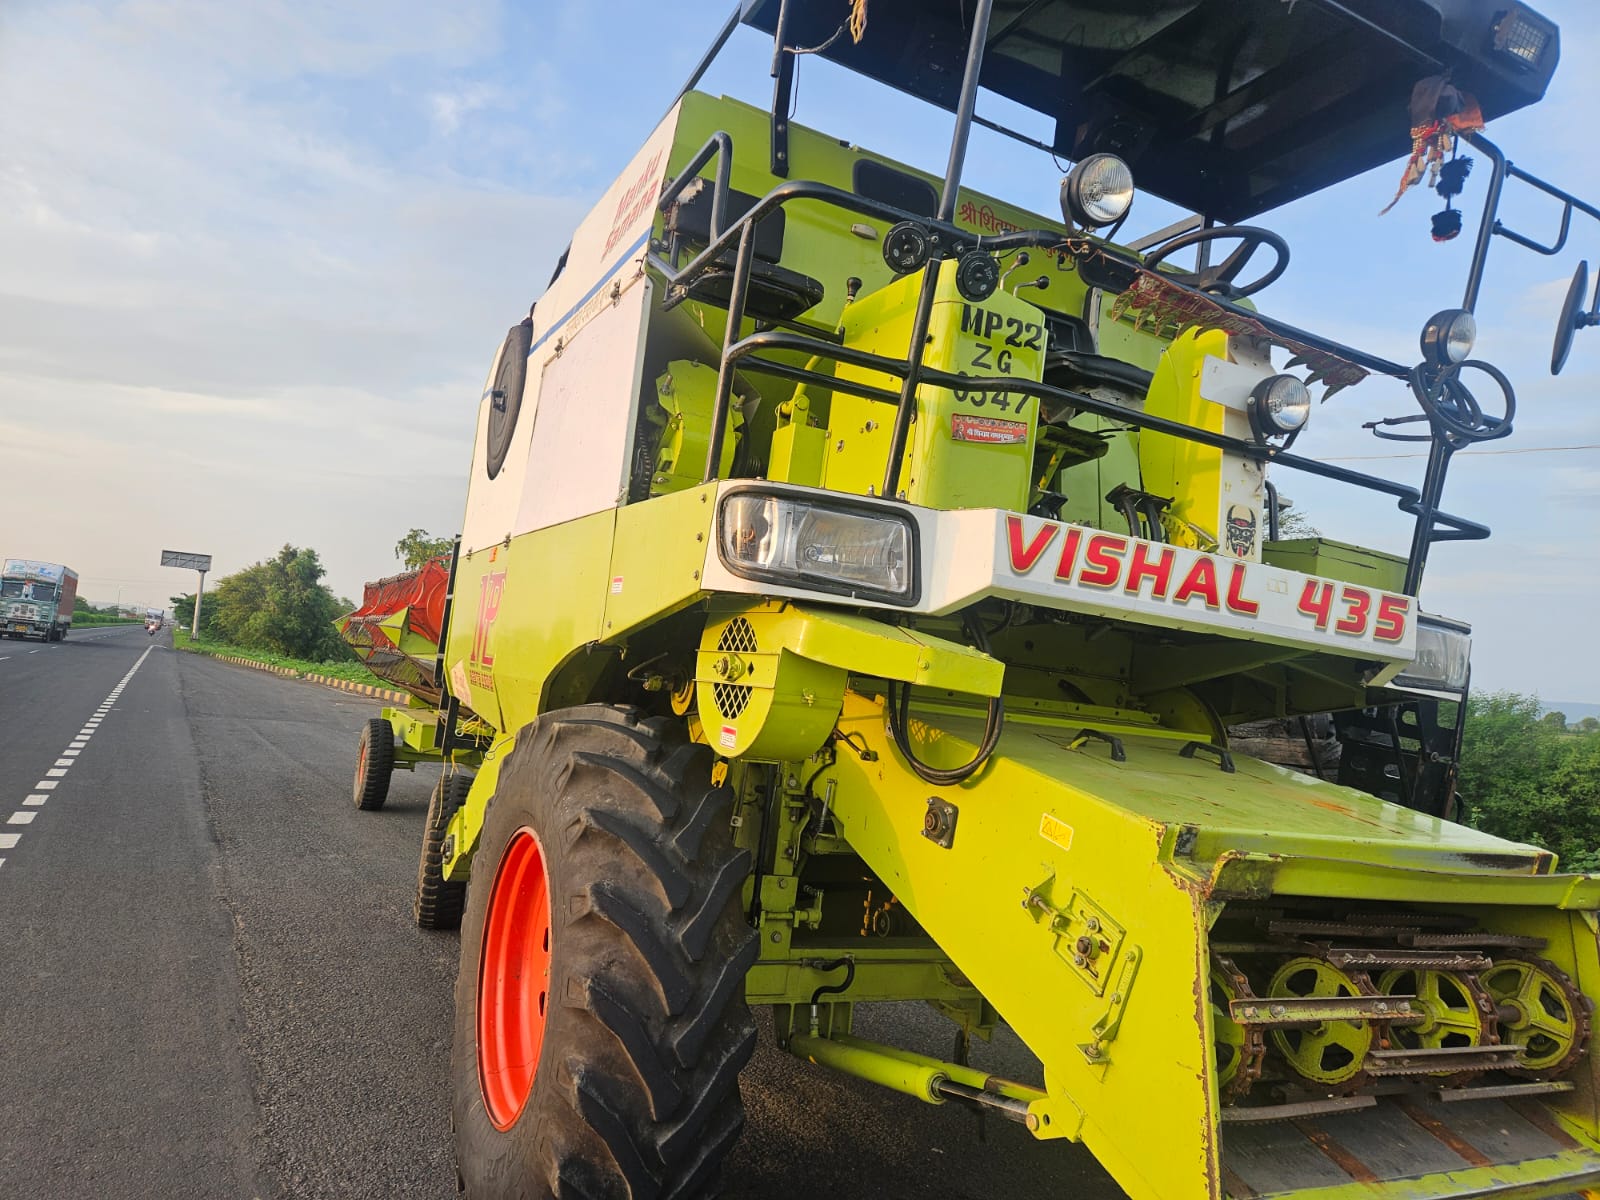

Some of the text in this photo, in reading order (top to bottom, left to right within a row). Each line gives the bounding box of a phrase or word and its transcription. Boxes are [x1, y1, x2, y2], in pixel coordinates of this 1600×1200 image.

[958, 201, 977, 225] श्री
[1006, 515, 1410, 641] VISHAL 435
